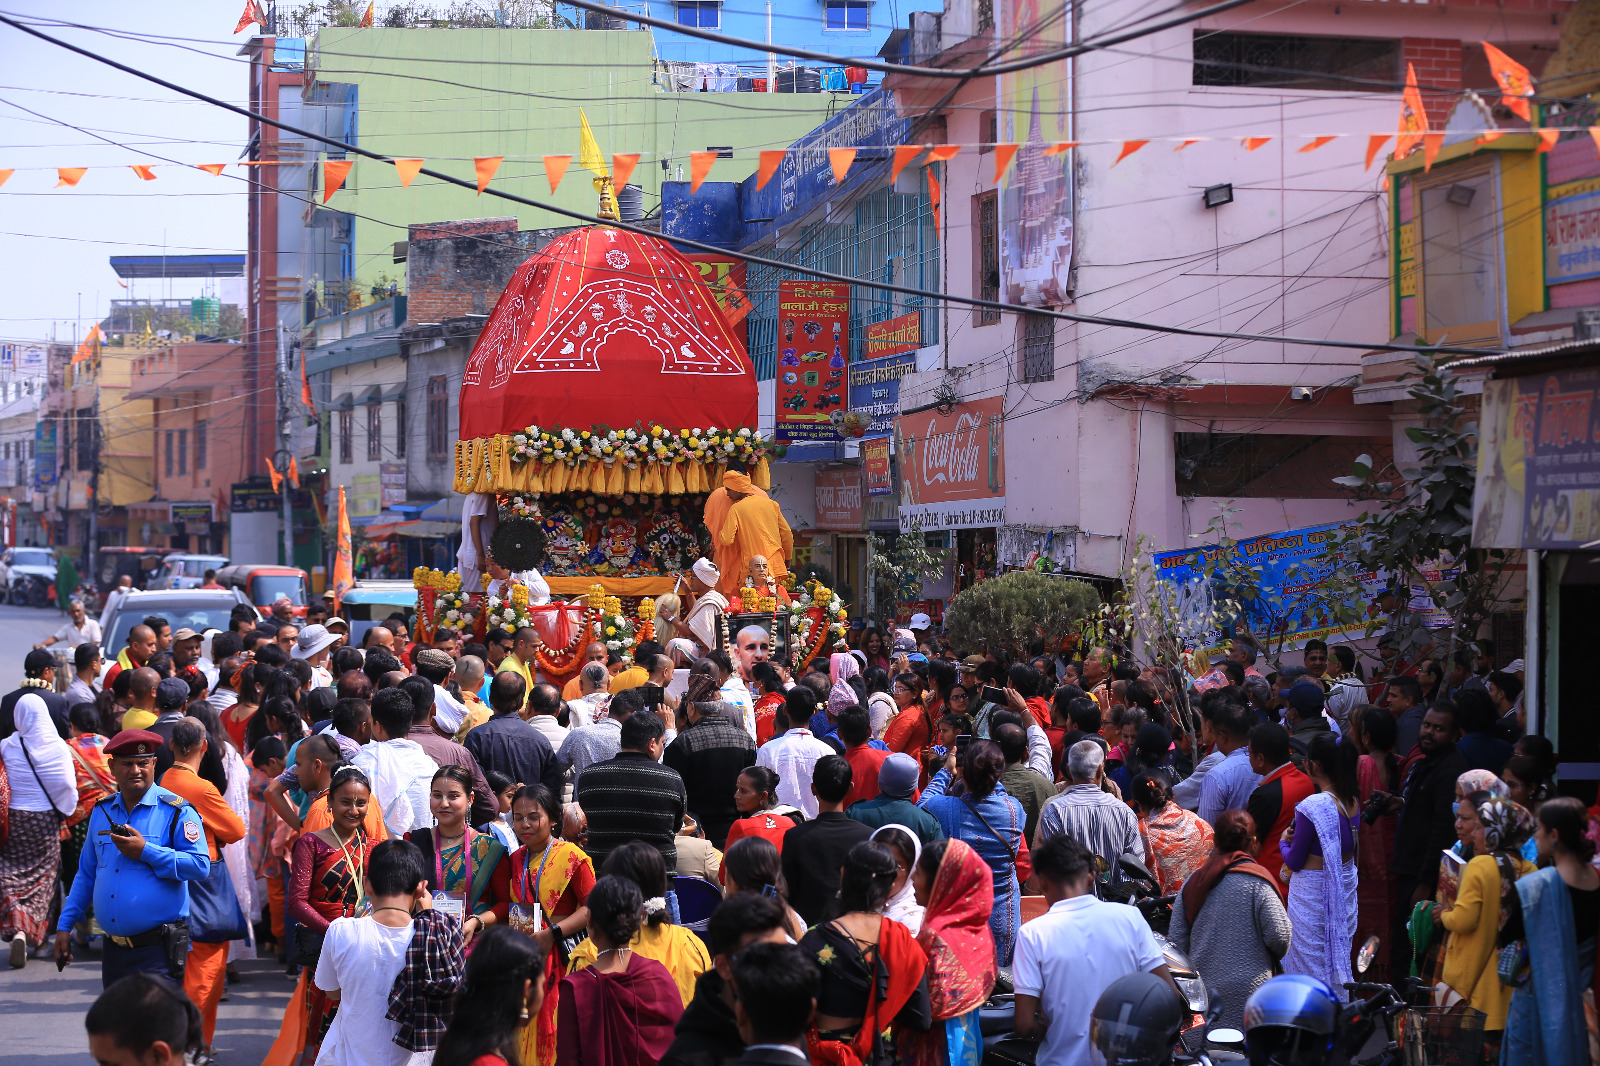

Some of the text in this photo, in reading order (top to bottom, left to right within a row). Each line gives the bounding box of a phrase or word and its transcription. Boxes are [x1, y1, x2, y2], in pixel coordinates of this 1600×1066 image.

[780, 301, 819, 311] बालाजी
[1538, 376, 1594, 448] मिलन
[816, 486, 834, 515] शुभम
[1244, 534, 1304, 557] प्रतिष्ठा
